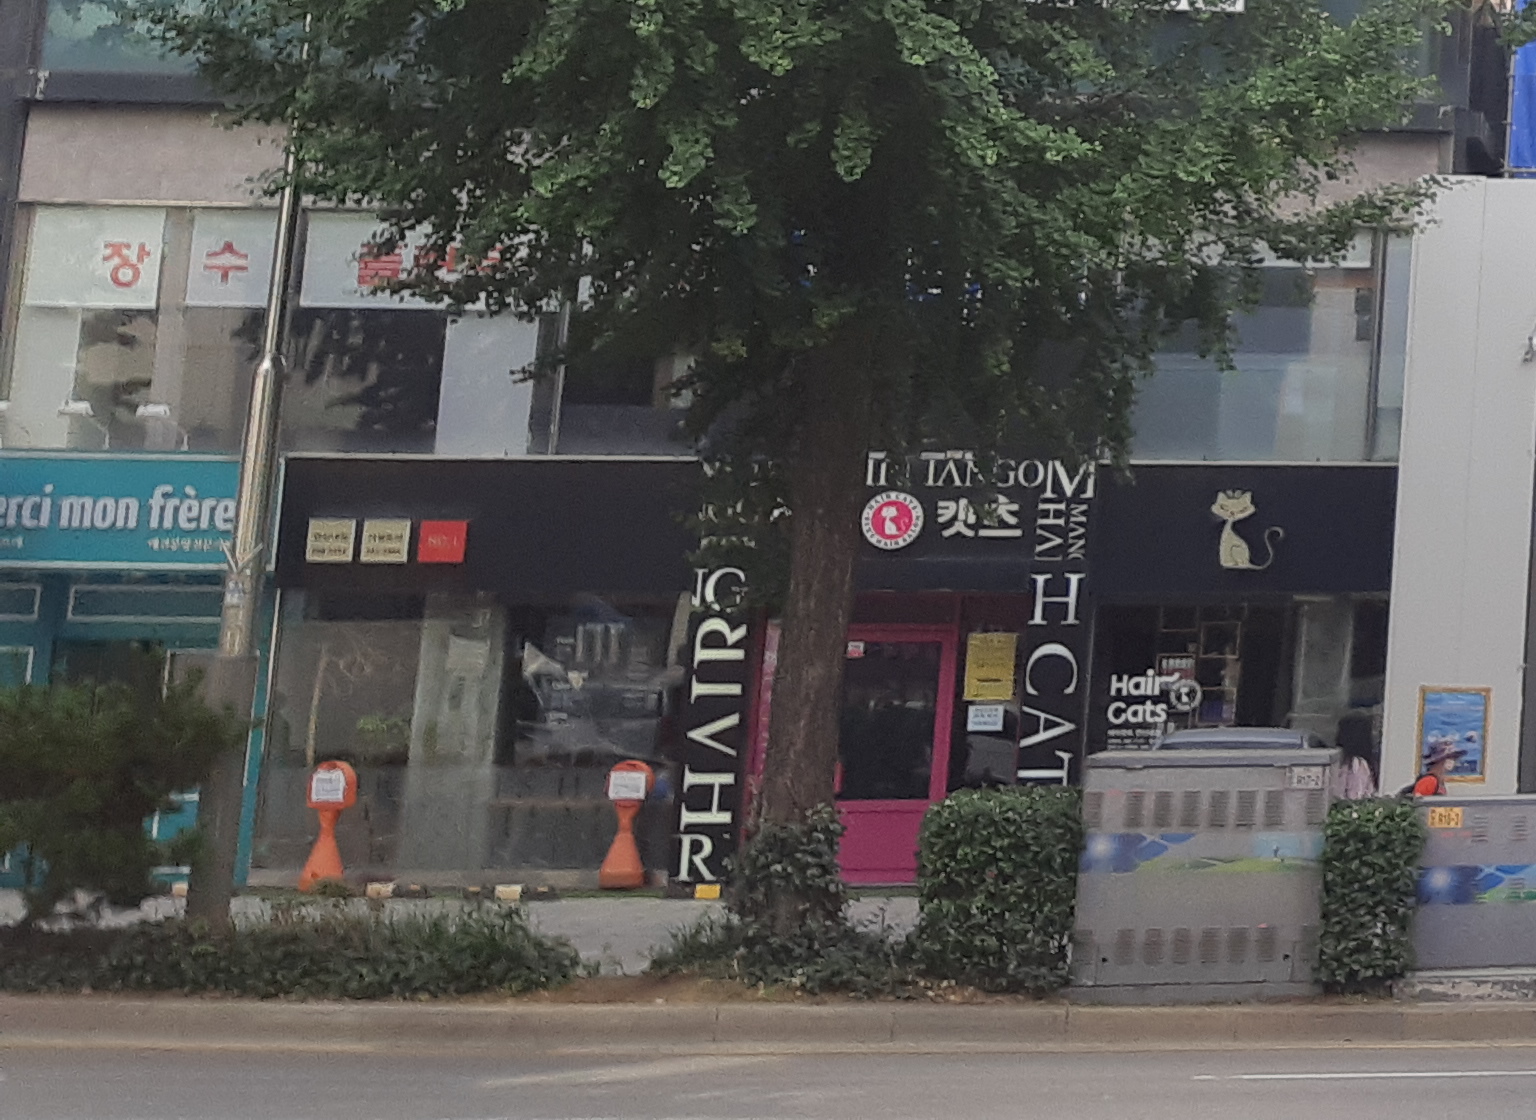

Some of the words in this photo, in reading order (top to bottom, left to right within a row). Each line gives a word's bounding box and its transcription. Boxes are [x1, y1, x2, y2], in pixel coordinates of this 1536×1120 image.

[0, 484, 53, 530] rci
[58, 496, 140, 530] mon
[148, 484, 236, 531] frère
[936, 496, 1024, 539] 캣츠
[1110, 668, 1181, 696] Hair
[1106, 700, 1169, 725] Cats
